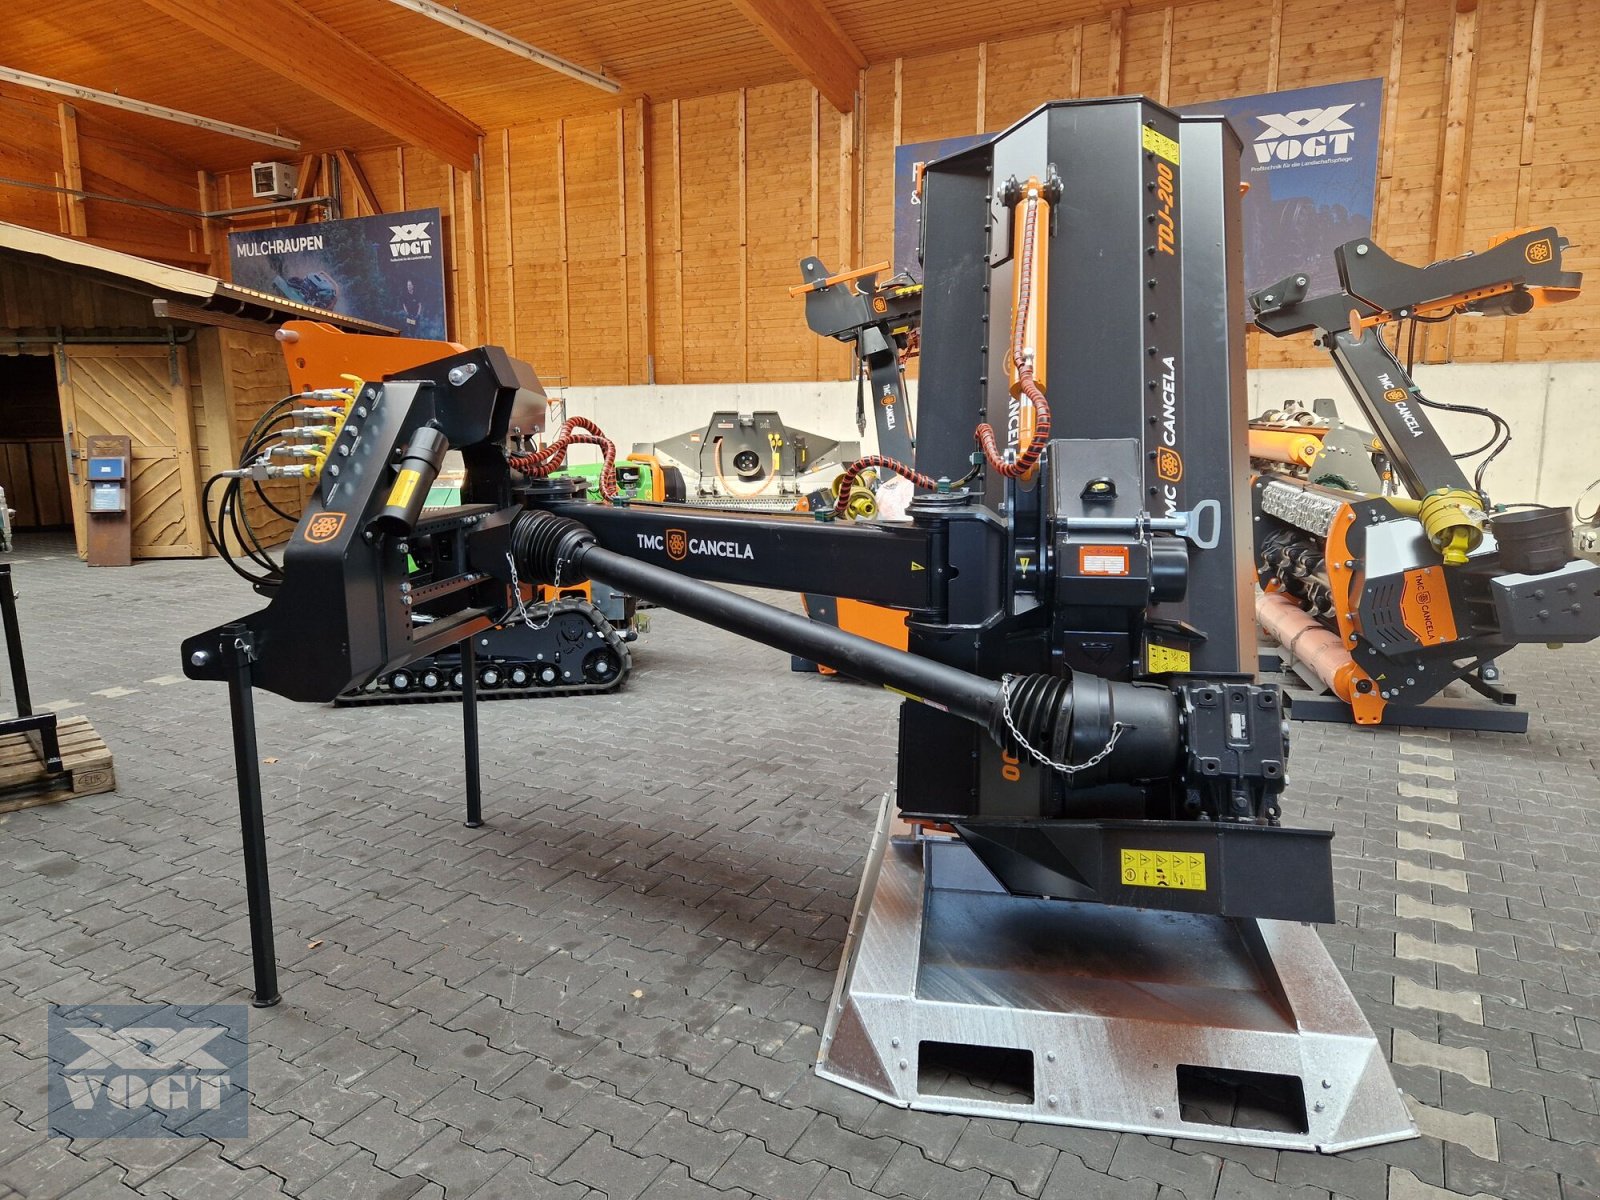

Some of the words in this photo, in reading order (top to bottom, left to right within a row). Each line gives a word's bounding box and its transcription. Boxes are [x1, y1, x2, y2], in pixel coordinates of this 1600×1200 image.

[1253, 132, 1355, 163] VOGT
[1157, 162, 1175, 256] TDJ-200
[236, 235, 323, 258] MULCHRAUPEN
[390, 239, 432, 257] VOGT
[1162, 356, 1176, 447] CANCELA
[1377, 373, 1395, 390] TMC
[1394, 401, 1424, 438] CANCELA
[1164, 484, 1177, 519] MC
[637, 533, 664, 551] TMC
[688, 538, 754, 560] CANCELA
[1416, 574, 1425, 591] TMC
[1421, 605, 1435, 640] CANCELA
